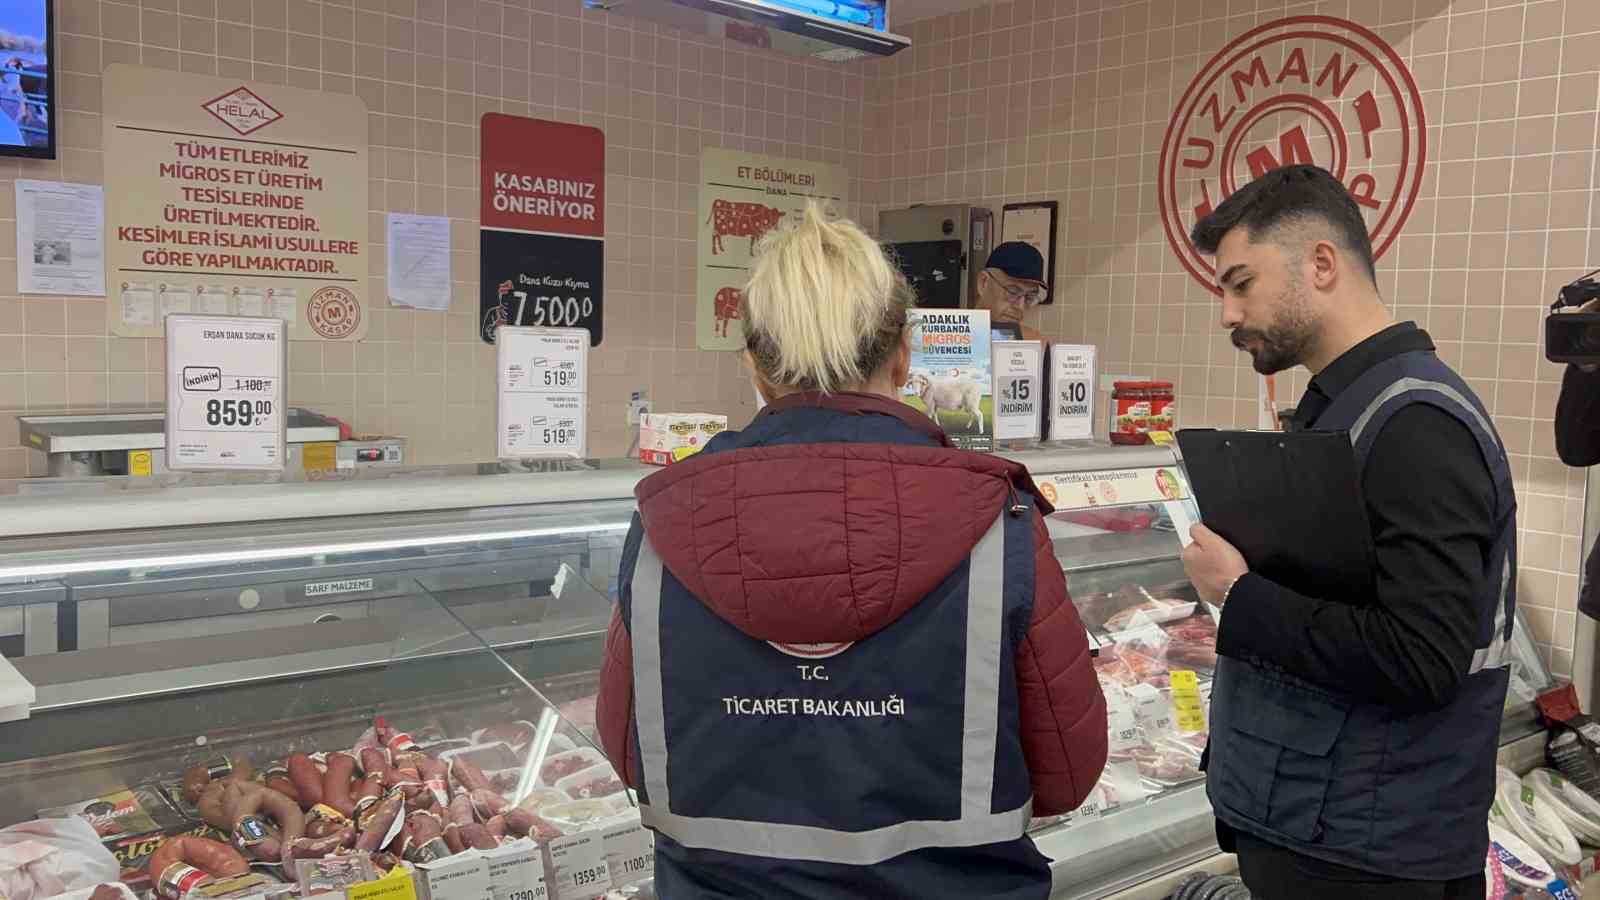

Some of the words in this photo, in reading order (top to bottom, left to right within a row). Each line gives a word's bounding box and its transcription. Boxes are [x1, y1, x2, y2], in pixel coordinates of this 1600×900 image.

[216, 104, 271, 120] HELAL
[1183, 48, 1359, 169] UZMAN
[175, 141, 216, 160] TÜM
[221, 147, 309, 169] ETLERİMİZ
[160, 161, 230, 183] MİGROS
[234, 170, 255, 185] ET
[258, 169, 323, 191] ÜRETİM
[494, 172, 596, 199] KASABINIZ
[737, 166, 752, 179] ET
[754, 166, 815, 187] BÖLÜMLERİ
[182, 187, 304, 210] TESİSLERİNDE
[766, 187, 787, 196] DANA
[493, 190, 595, 220] ÖNERİYOR
[164, 206, 320, 232] ÜRETİLMEKTEDİR.
[118, 225, 211, 246] KESİMLER
[214, 229, 272, 249] İSLAMİ
[275, 238, 359, 255] USULLERE
[142, 248, 192, 266] GÖRE
[196, 252, 338, 274] YAPILMAKTADIR.
[313, 292, 349, 310] UZMAN
[921, 314, 969, 324] ADAKLIK
[922, 325, 971, 333] KURBANDA
[186, 373, 219, 387] İNDİRİM
[306, 584, 329, 594] SARF
[331, 580, 371, 592] MALZEME
[797, 665, 829, 681] T.C.
[722, 695, 799, 715] TİCARET
[803, 694, 905, 716] BAKANLIĞI
